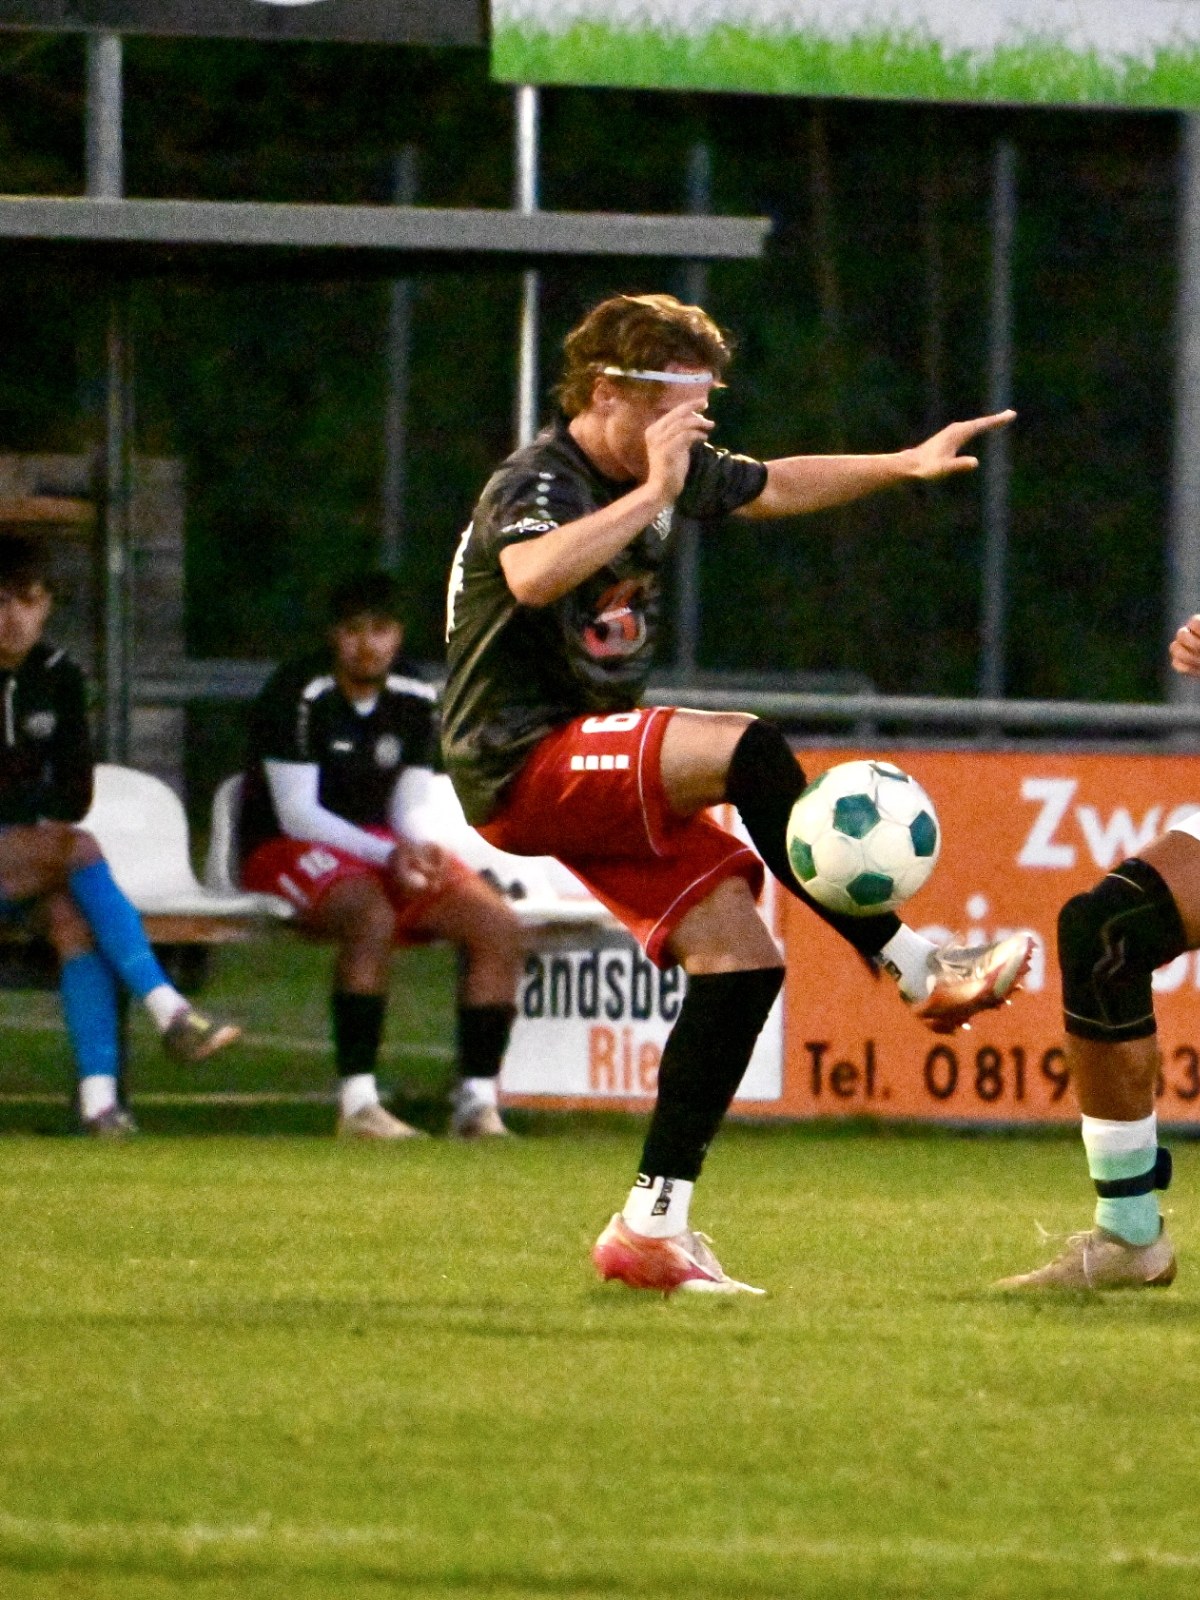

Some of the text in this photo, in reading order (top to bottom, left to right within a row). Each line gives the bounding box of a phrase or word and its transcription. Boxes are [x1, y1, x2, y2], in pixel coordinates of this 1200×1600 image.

[523, 948, 681, 1021] andsbe
[589, 1024, 663, 1092] Rie
[803, 1041, 890, 1099] Tel.
